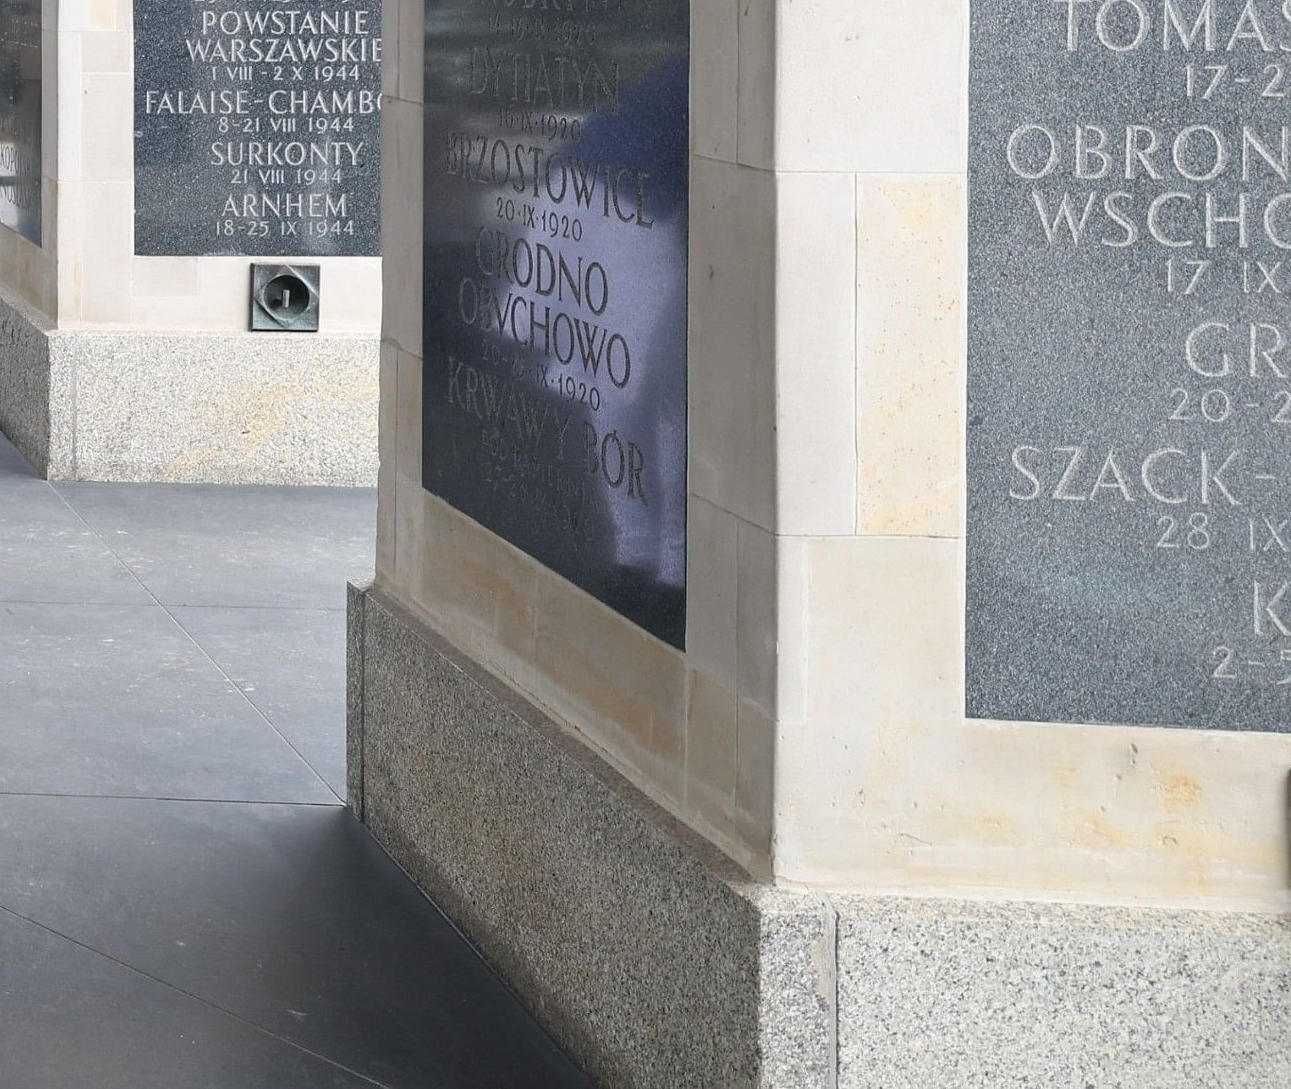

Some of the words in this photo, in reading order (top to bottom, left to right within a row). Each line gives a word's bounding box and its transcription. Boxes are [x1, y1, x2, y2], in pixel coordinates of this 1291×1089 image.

[203, 11, 369, 35] POWSTANIE
[227, 67, 253, 80] VIII
[273, 67, 284, 80] 2
[292, 67, 302, 80] X
[315, 65, 360, 81] 1944
[219, 117, 260, 133] 8-21
[270, 118, 296, 132] VIII
[308, 117, 354, 133] 1944
[211, 142, 364, 166] SURKONTY
[231, 170, 248, 184] 21
[259, 170, 284, 184] VIII
[297, 168, 341, 184] 1944
[222, 193, 348, 217] ARNHEM
[216, 221, 268, 236] 18-25
[281, 221, 297, 235] IX
[309, 220, 354, 236] 1944
[476, 225, 609, 316] GRODNO
[1156, 512, 1211, 550] 28
